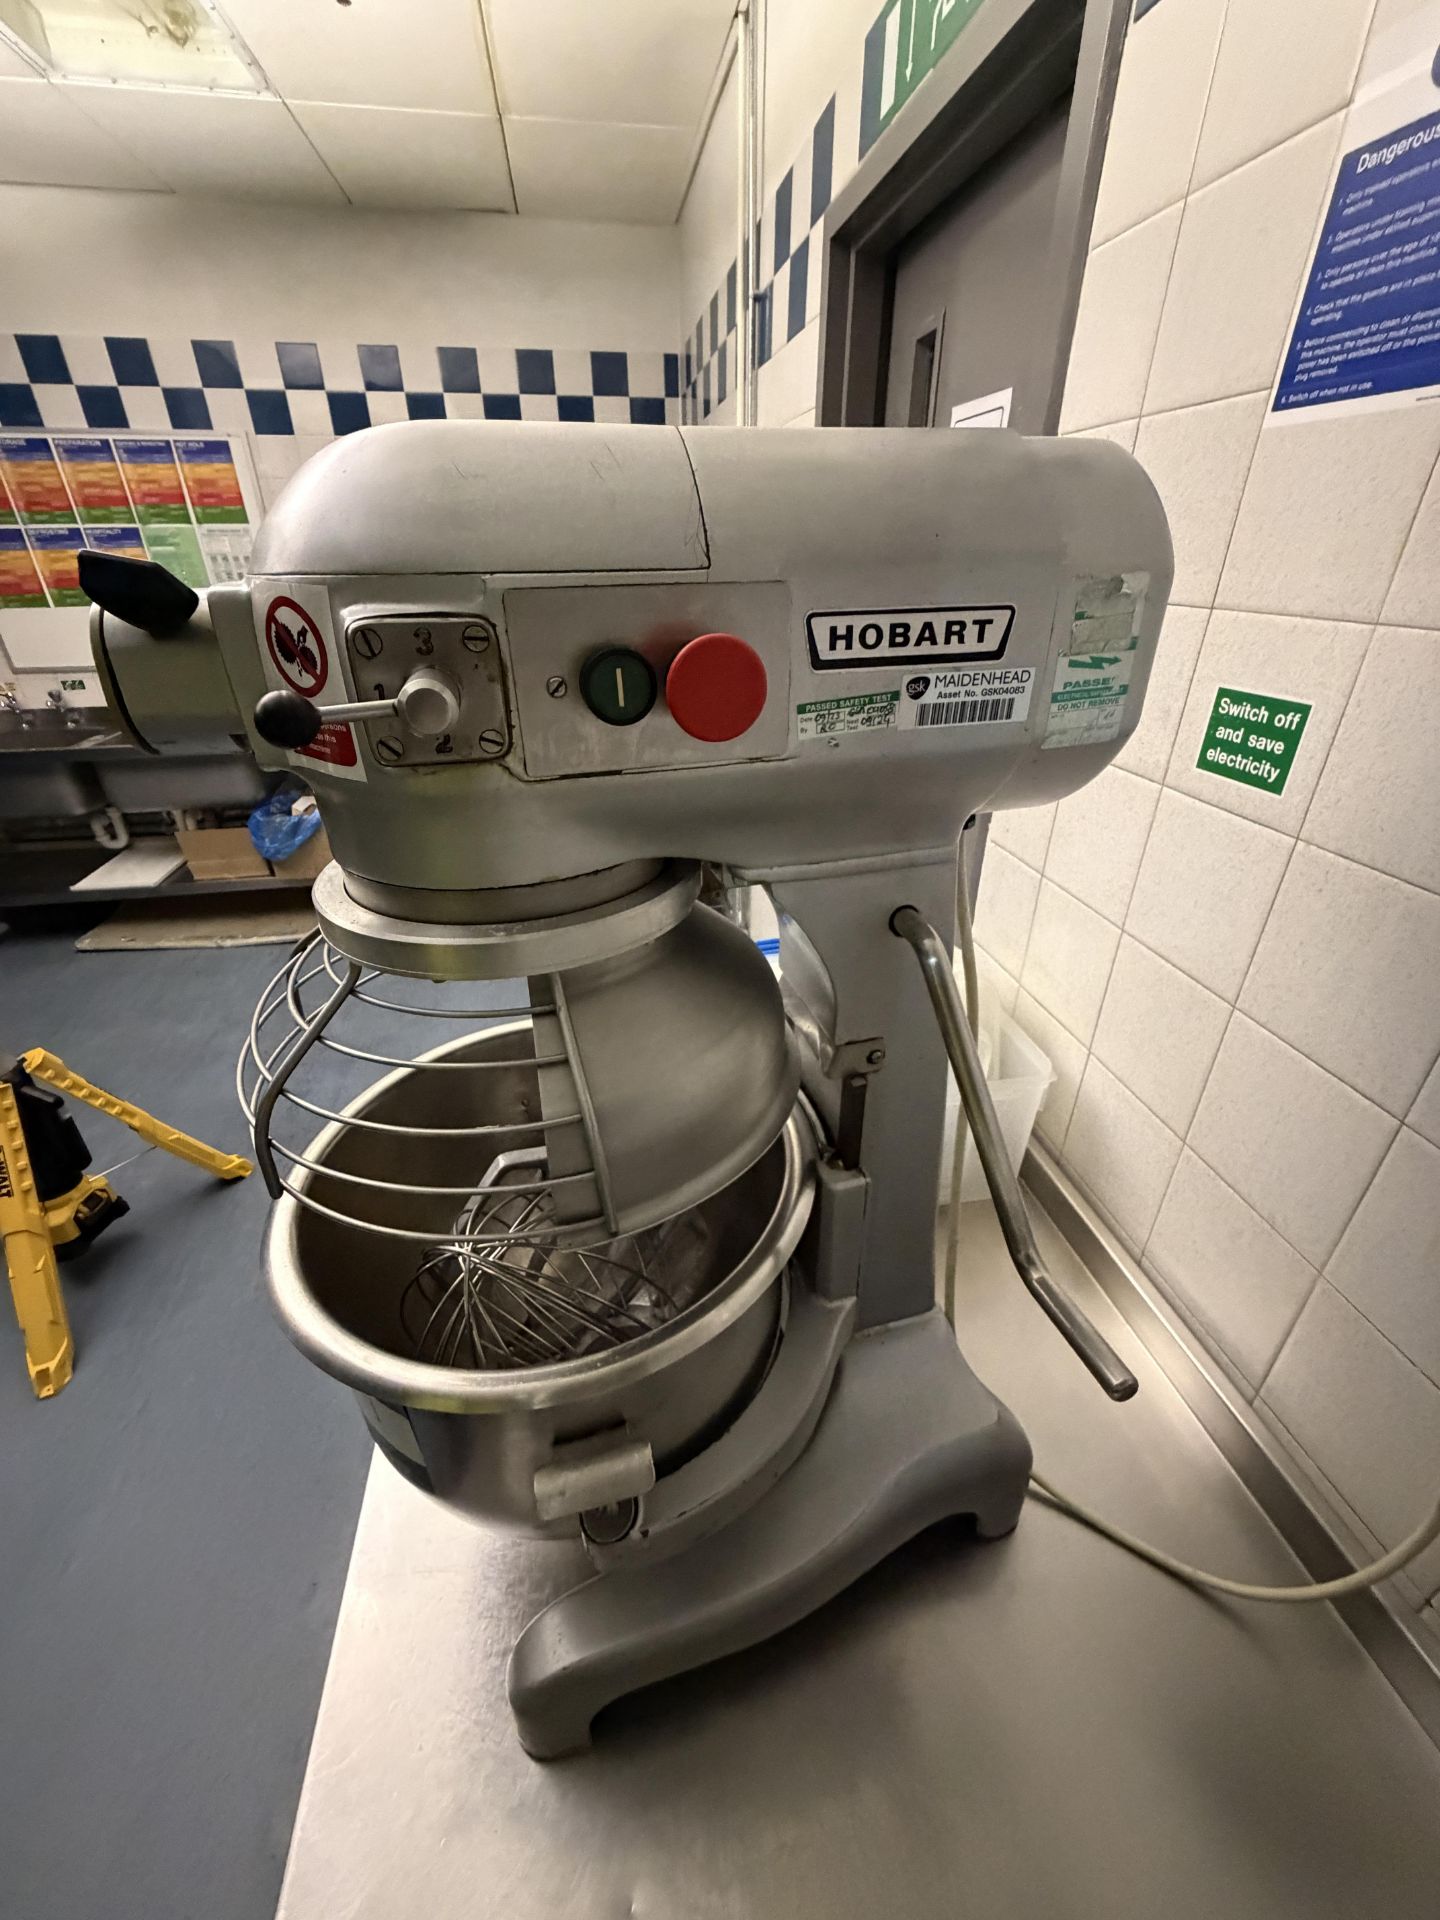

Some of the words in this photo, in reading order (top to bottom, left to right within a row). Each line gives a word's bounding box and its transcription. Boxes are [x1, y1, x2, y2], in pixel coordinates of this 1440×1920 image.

[1370, 322, 1379, 332] to
[413, 627, 434, 656] 3
[829, 619, 994, 651] HOBART
[907, 680, 927, 696] gsk
[934, 669, 1032, 689] MAIDENHEAD
[1063, 676, 1116, 690] PASSE
[805, 702, 837, 713] PASSED
[839, 697, 871, 708] SAFETY
[872, 693, 892, 703] TEST
[936, 689, 961, 700] Asset
[964, 688, 978, 698] No.
[980, 686, 1026, 697] GSK04083
[1057, 703, 1069, 712] DO
[1070, 701, 1086, 710] NOT
[1088, 697, 1121, 707] REMOVE
[1218, 697, 1269, 724] Switch
[1273, 711, 1302, 731] off
[435, 733, 454, 754] 2
[1215, 725, 1245, 744] and
[1247, 734, 1285, 755] save
[1206, 746, 1281, 783] electricity
